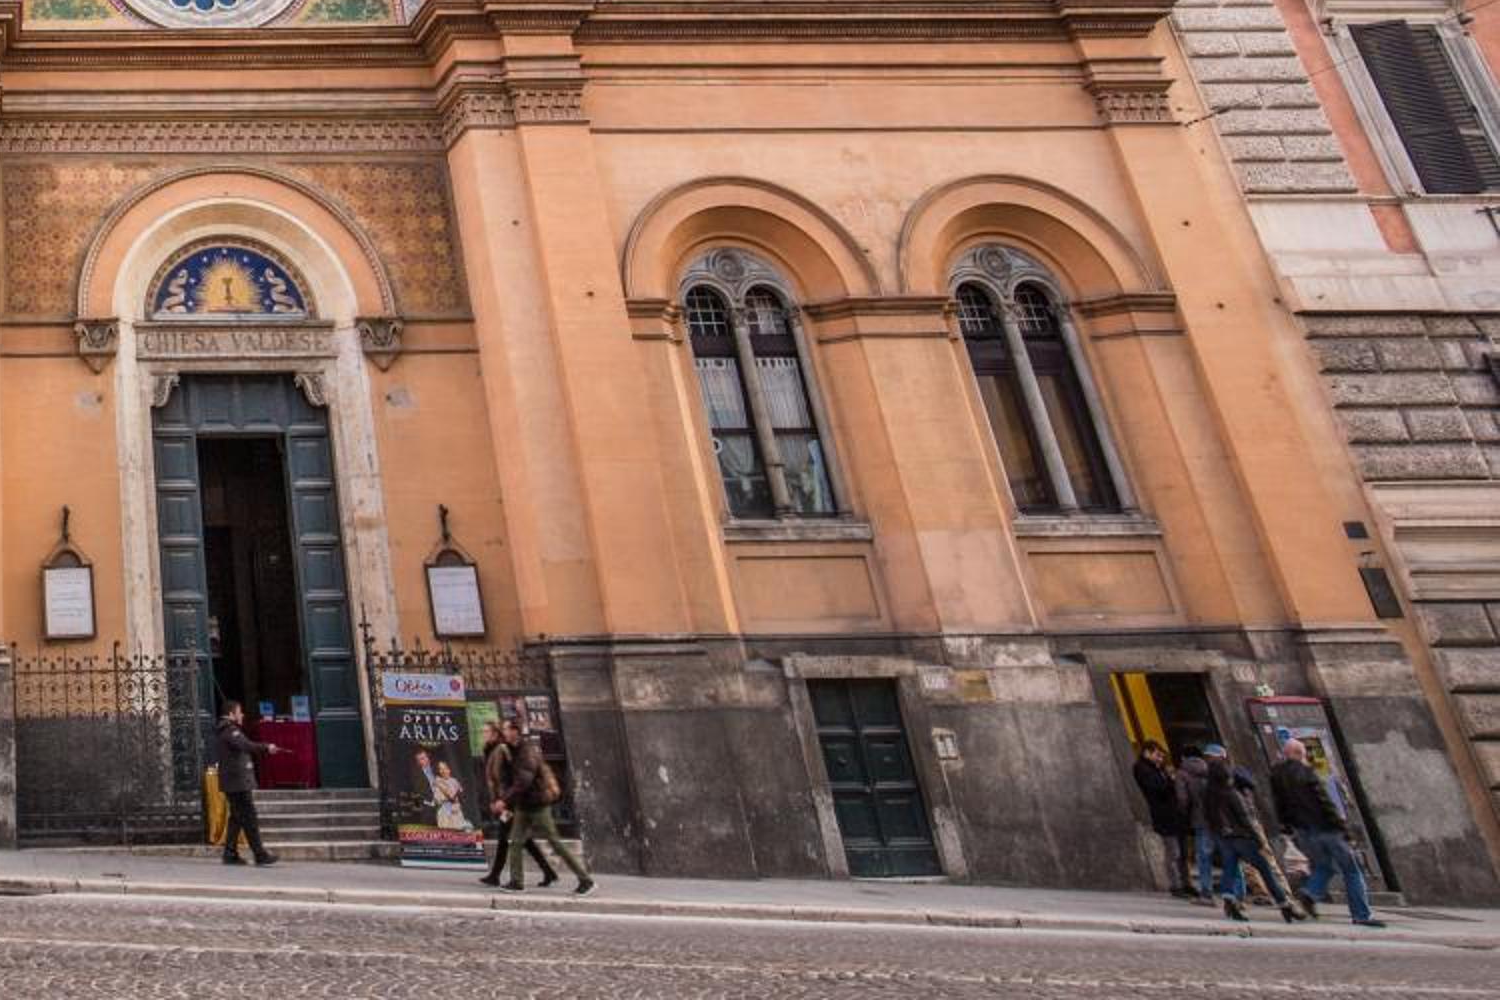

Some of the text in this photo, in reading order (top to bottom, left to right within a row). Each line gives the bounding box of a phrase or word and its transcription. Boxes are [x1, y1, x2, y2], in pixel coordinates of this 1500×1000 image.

[143, 331, 327, 352] CHIESA VALDESE
[403, 713, 453, 725] OPERA
[399, 725, 460, 741] ARIAS
